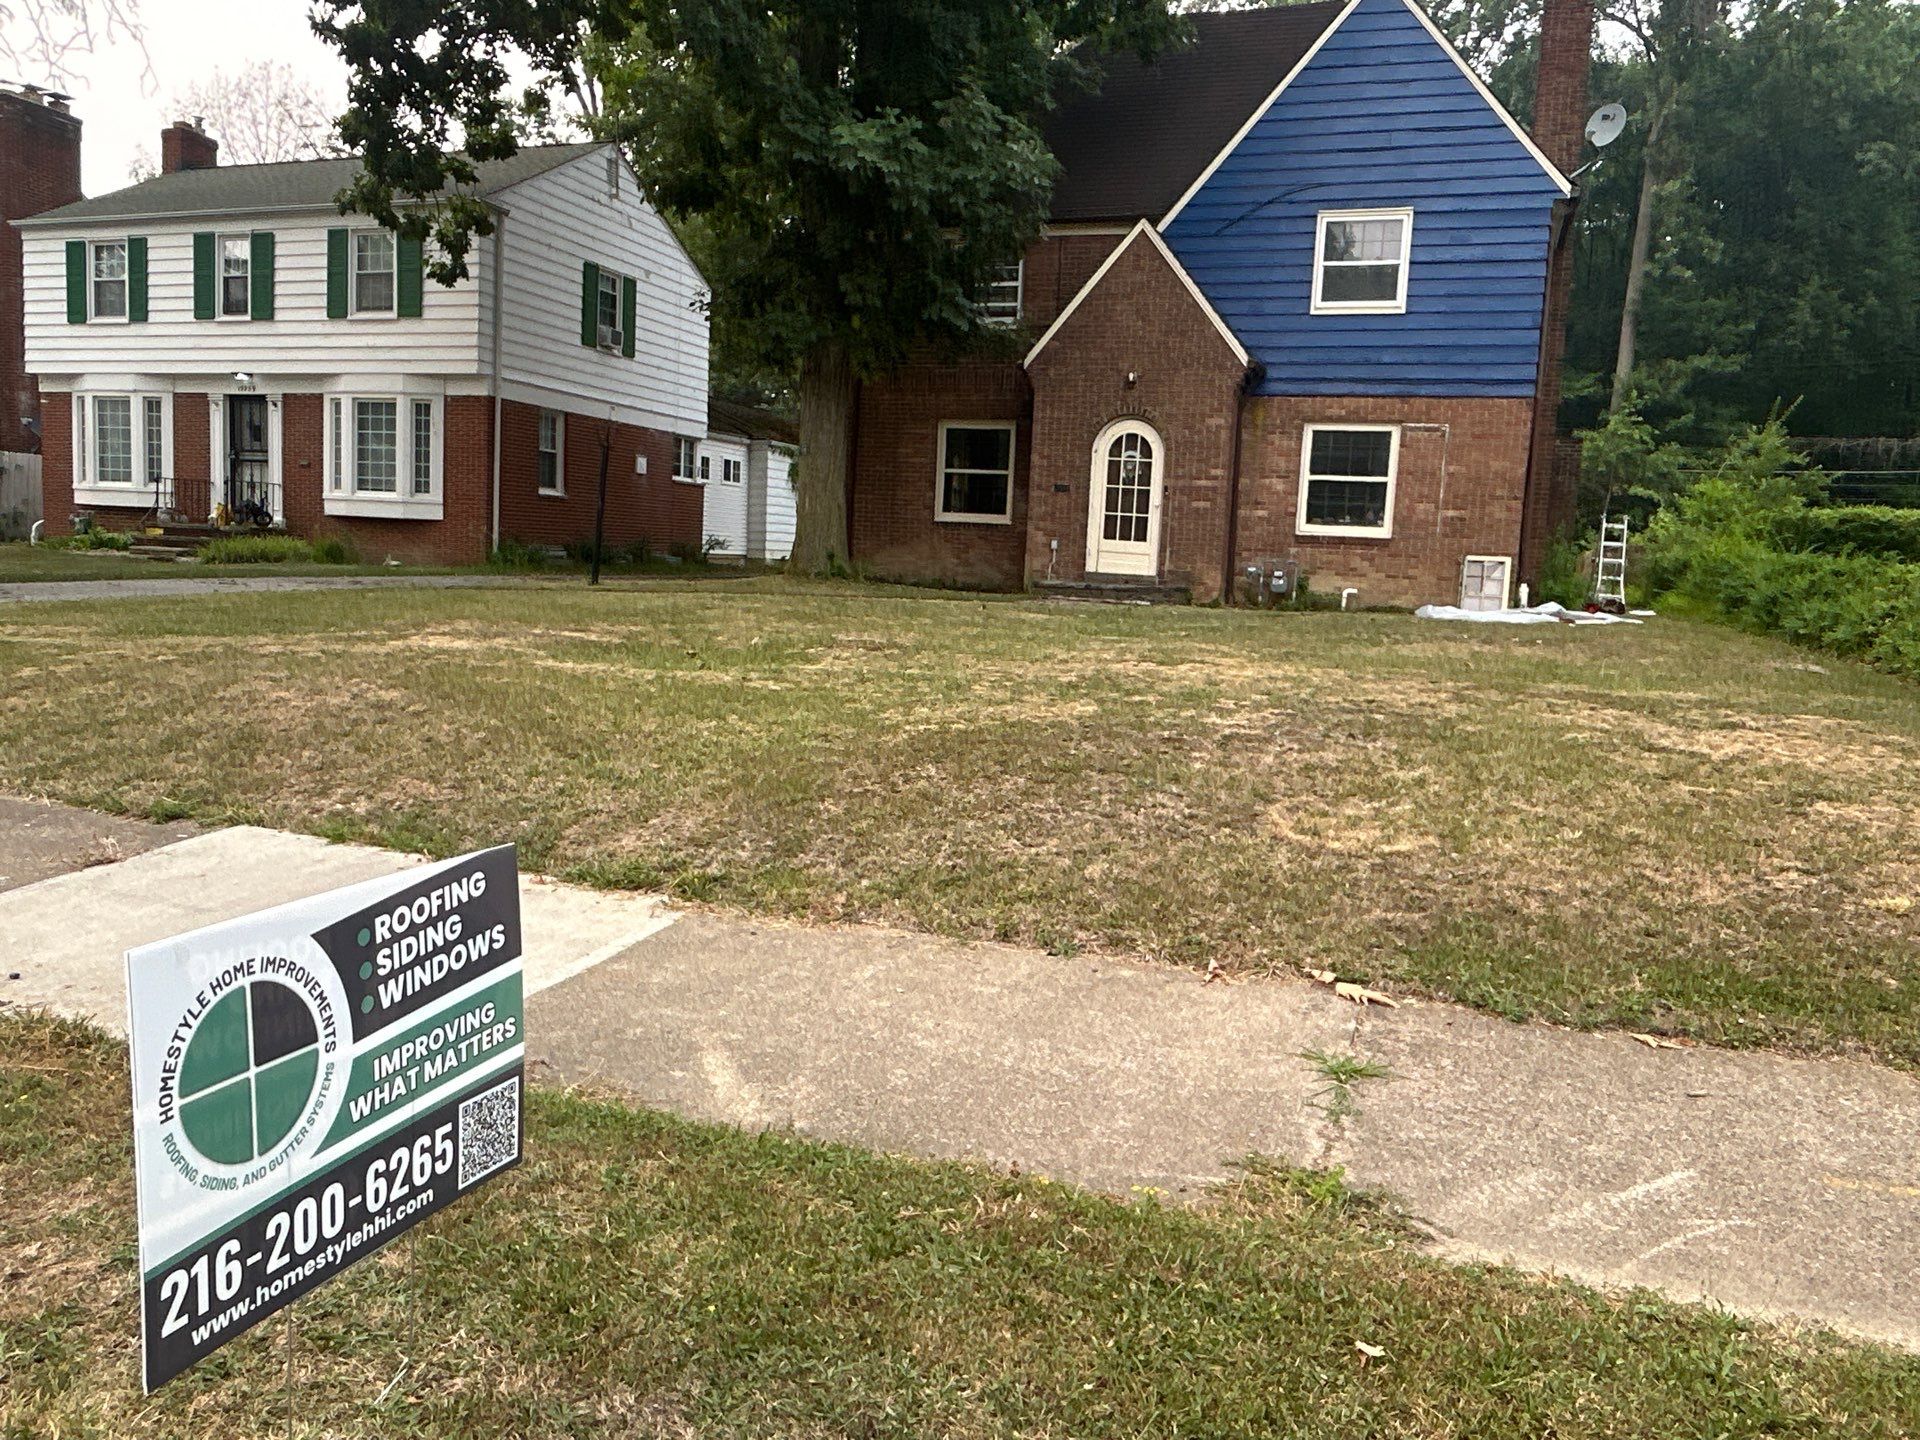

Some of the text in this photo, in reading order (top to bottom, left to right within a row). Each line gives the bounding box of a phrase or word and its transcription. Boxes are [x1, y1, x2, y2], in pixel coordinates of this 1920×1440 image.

[374, 871, 486, 944] ROOFING
[376, 914, 462, 976] SIDING
[377, 923, 506, 1010] WINDOWS
[158, 956, 337, 1125] HOMESTYLE HOME IMPROVEMENTS
[349, 1016, 516, 1123] WHAT MATTERS
[373, 1002, 496, 1082] IMPROVING
[162, 1062, 335, 1191] ROOFING, SIDING, AND GUTTER SYSTEMS
[160, 1122, 454, 1339] 216-200-6265
[191, 1188, 434, 1346] www.homestylehhi.com
